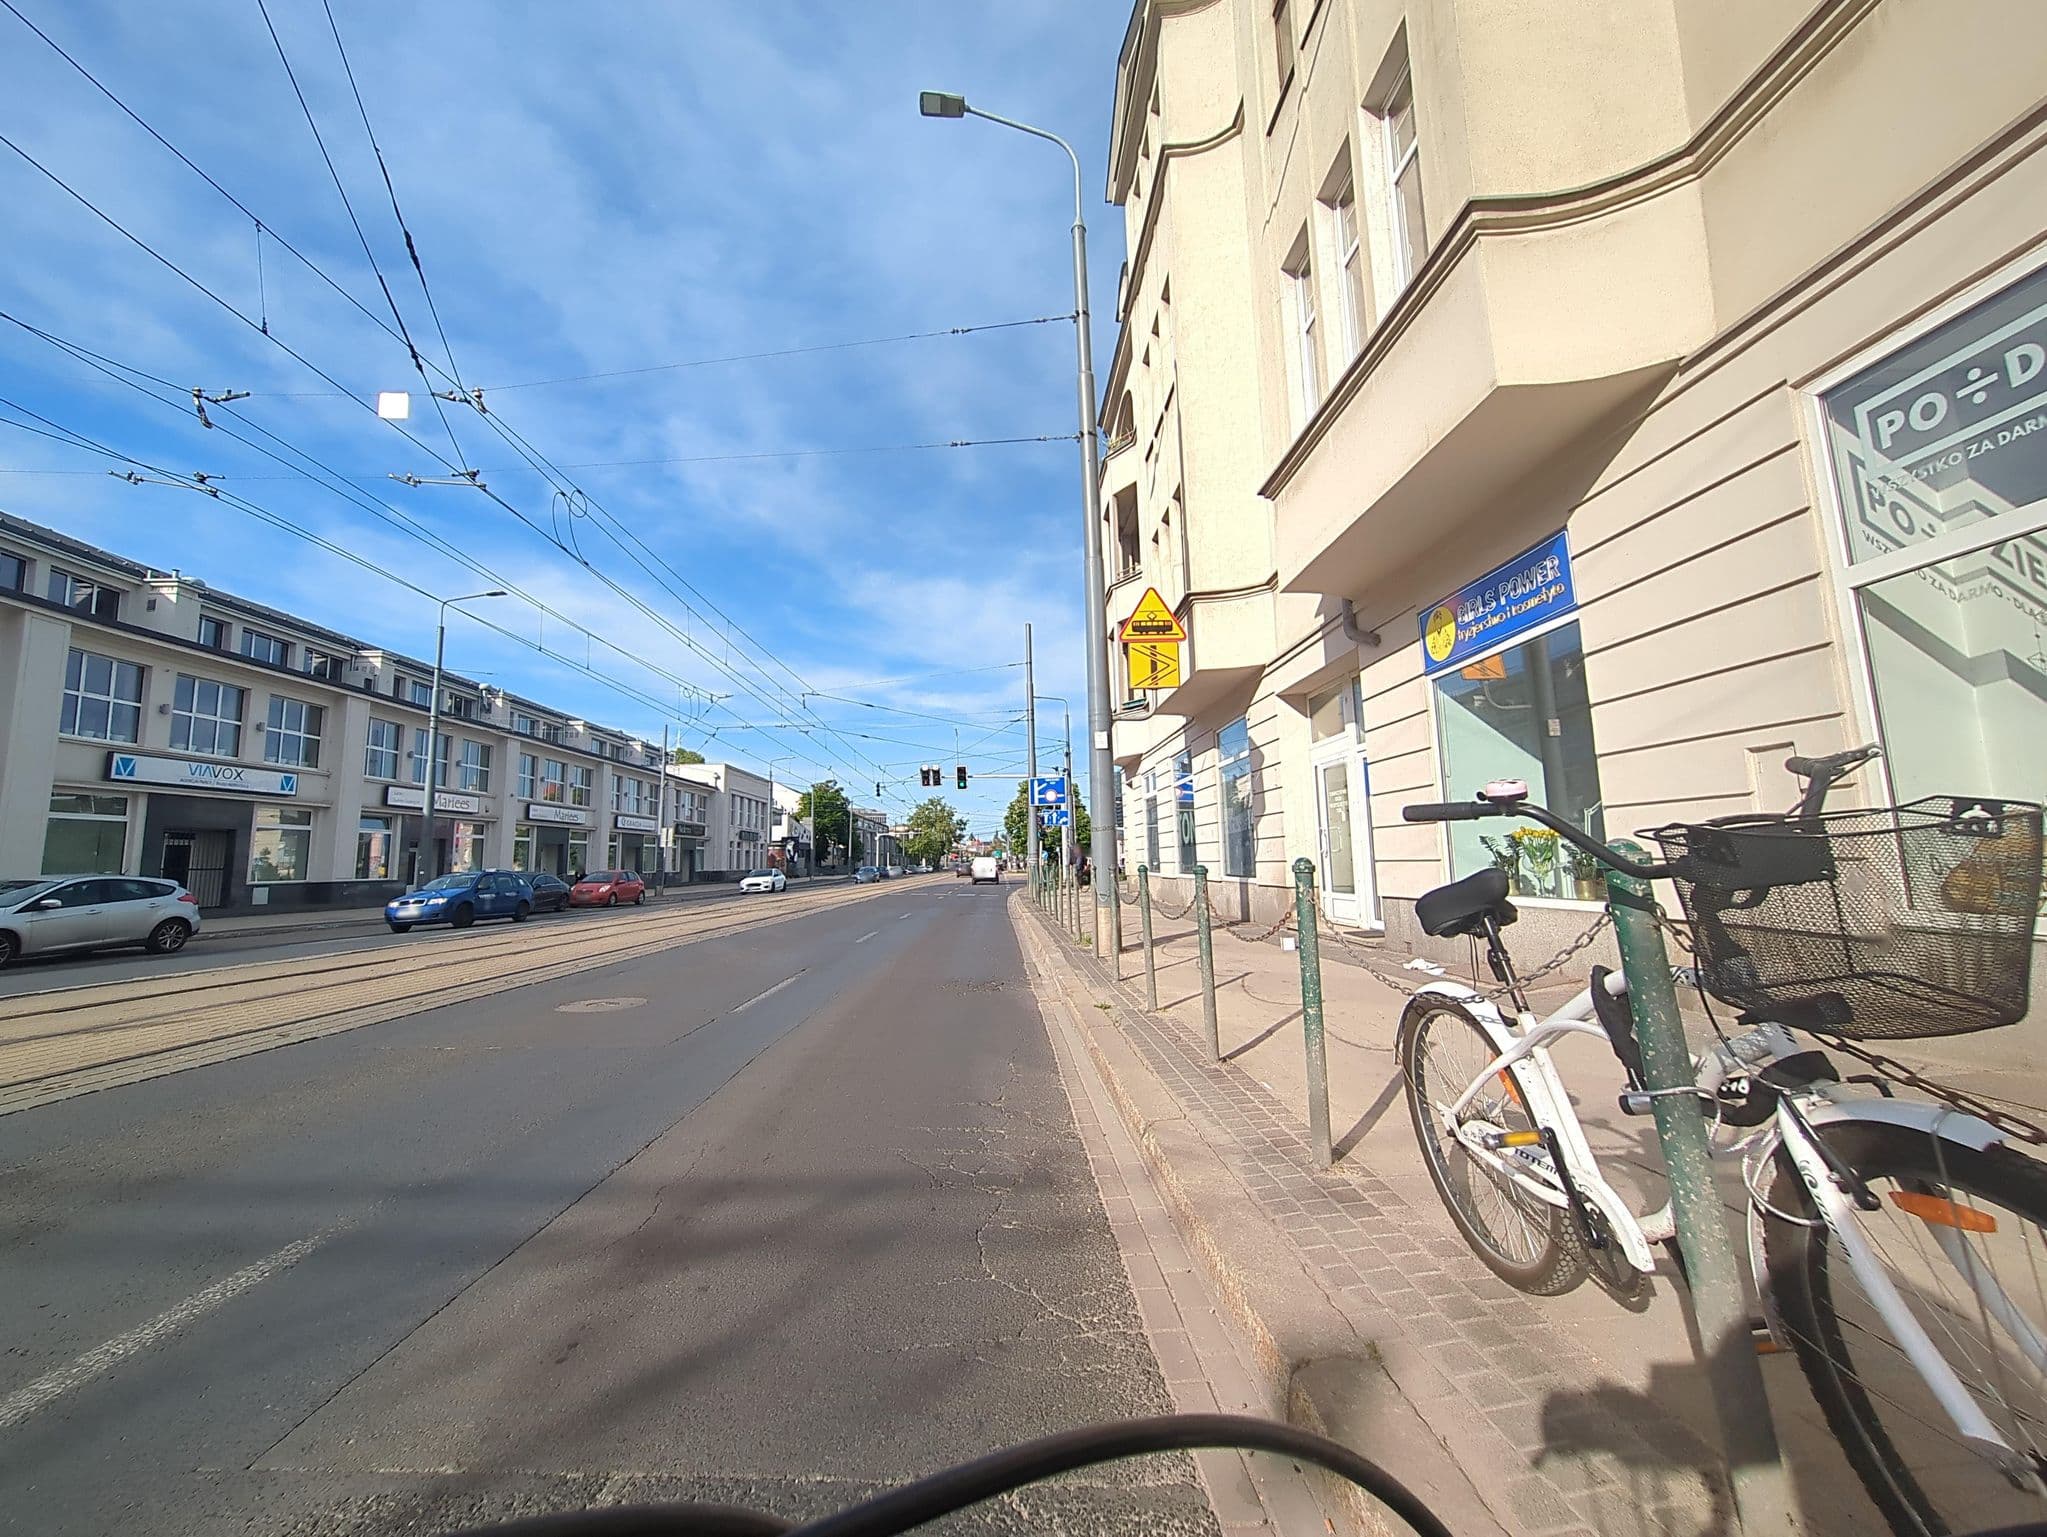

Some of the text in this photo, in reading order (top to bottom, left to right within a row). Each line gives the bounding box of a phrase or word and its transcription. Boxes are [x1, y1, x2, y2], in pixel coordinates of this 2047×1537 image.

[1966, 440, 1996, 460] ZA
[1499, 555, 1561, 606] POWER
[188, 763, 245, 781] VIAVOX
